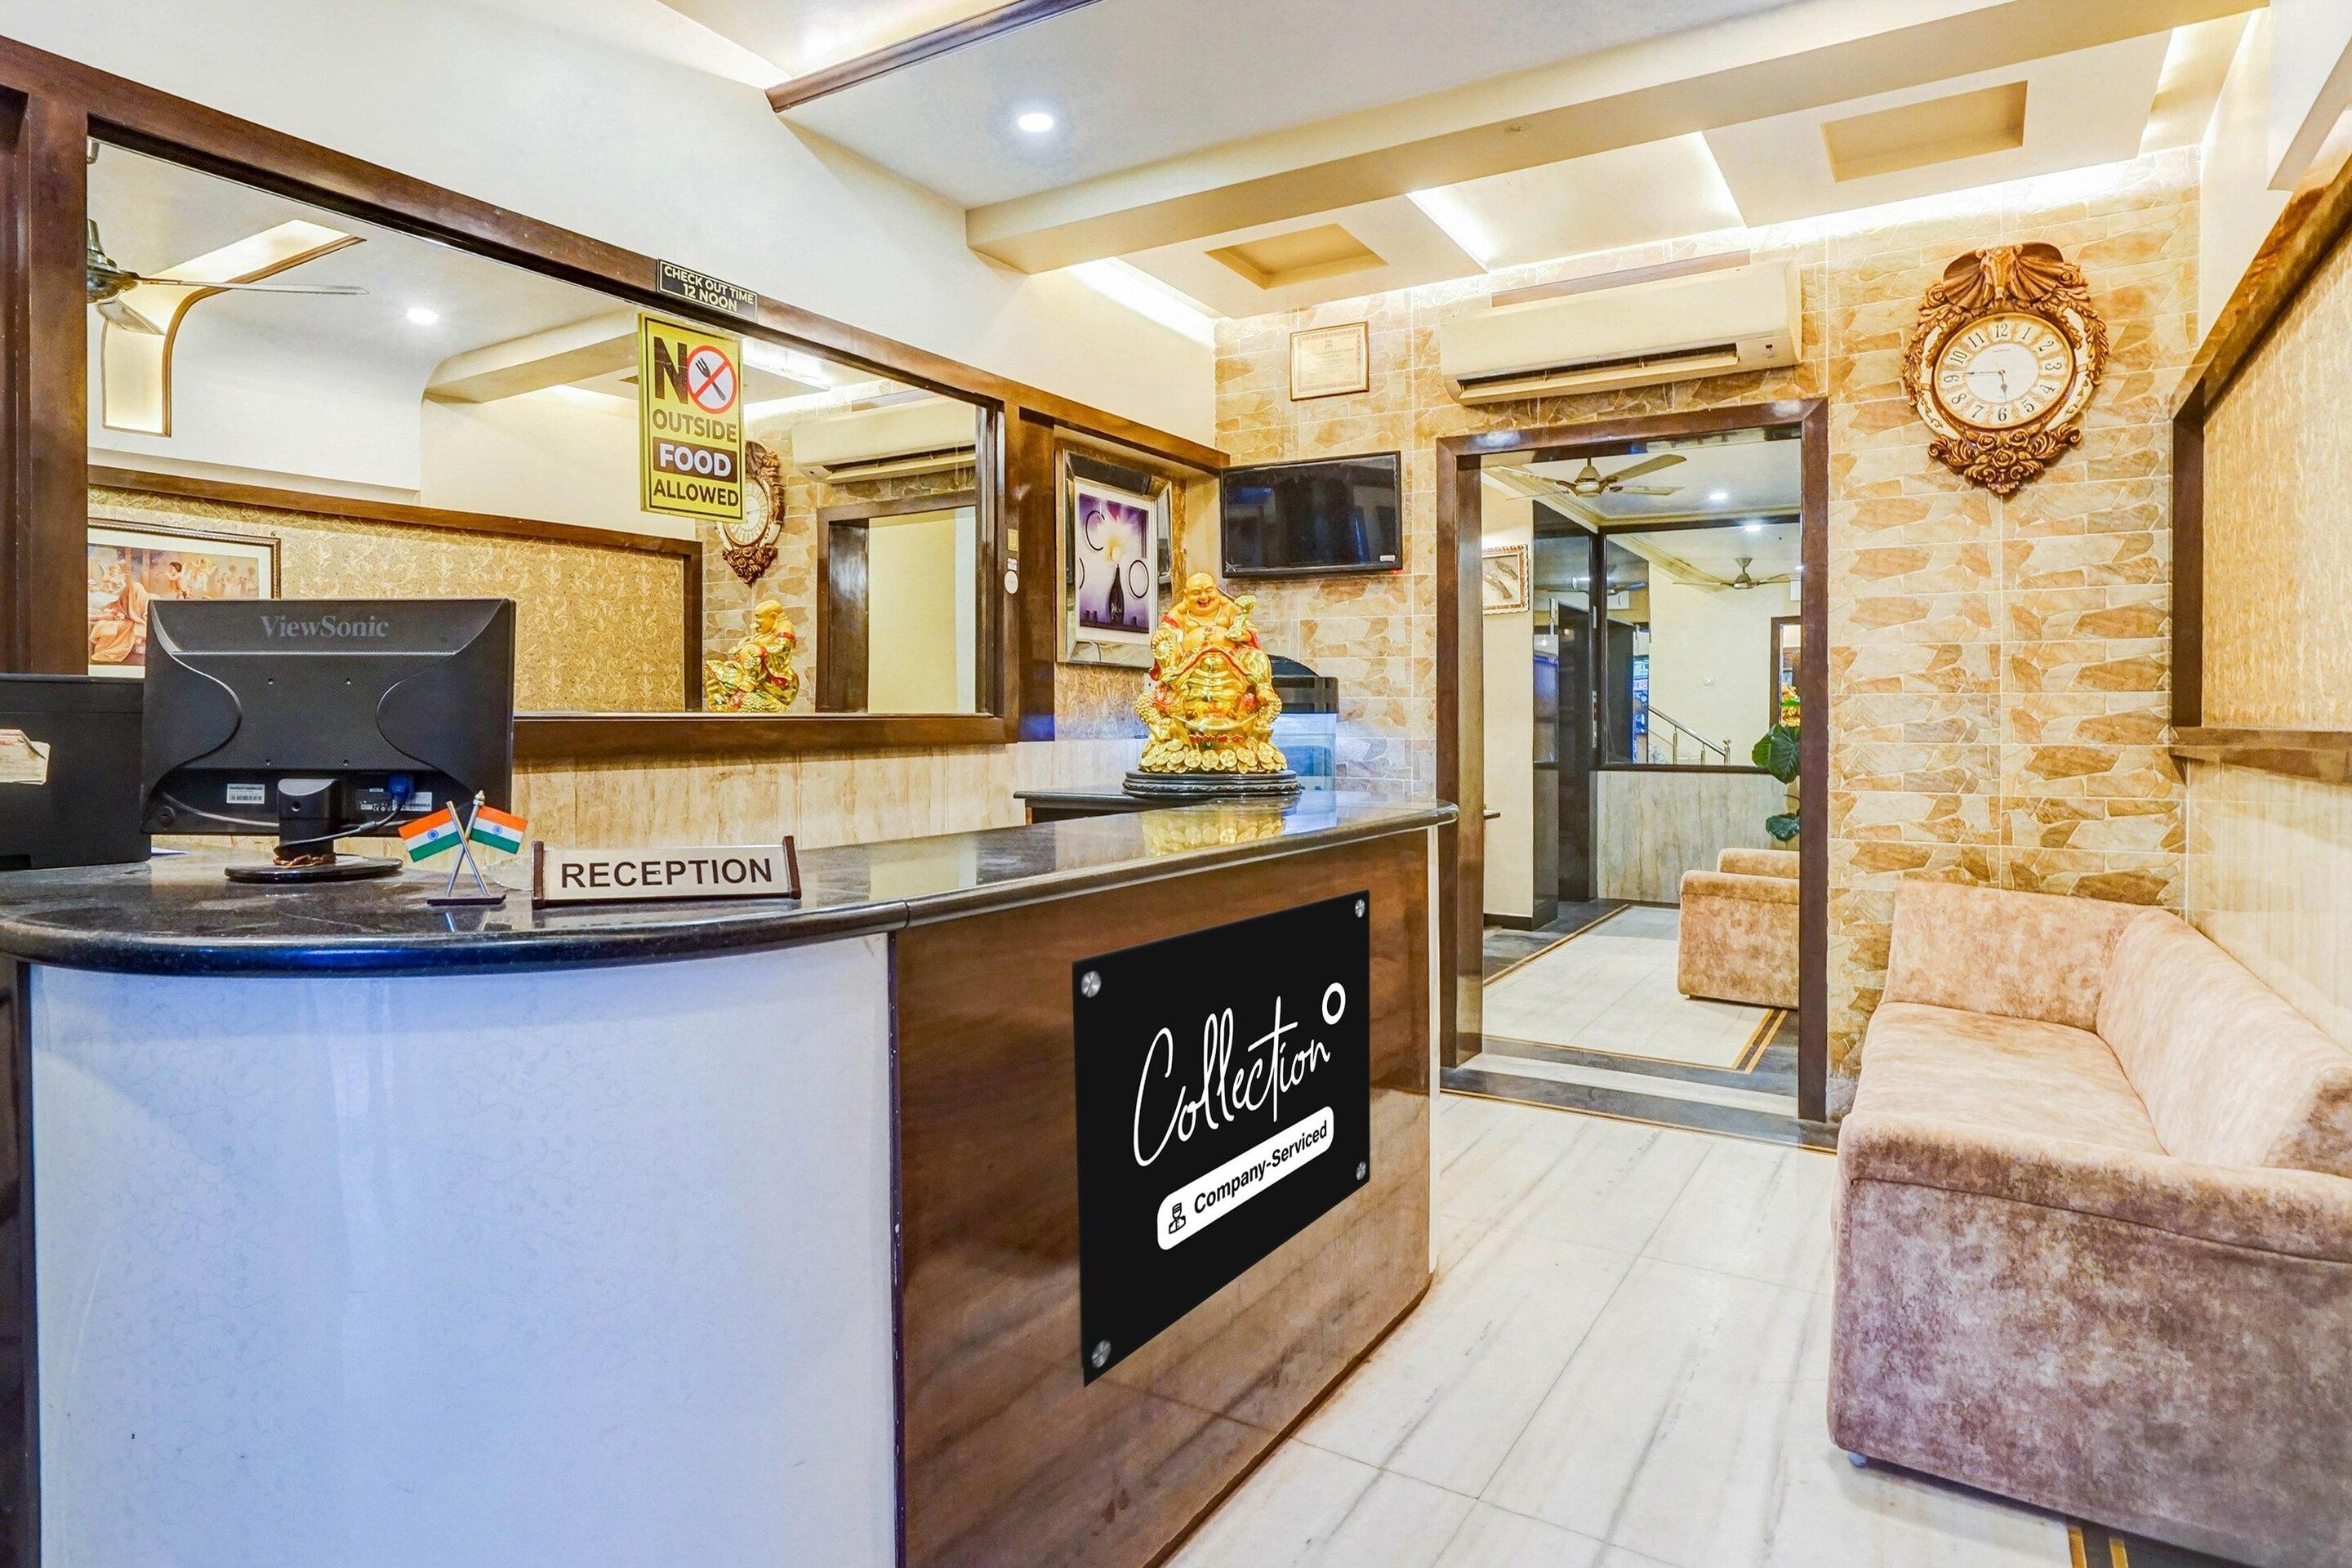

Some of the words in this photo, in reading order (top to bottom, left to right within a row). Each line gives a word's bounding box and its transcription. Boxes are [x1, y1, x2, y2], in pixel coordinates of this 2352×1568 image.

[664, 265, 703, 287] CHECK
[705, 279, 728, 295] OUT
[729, 287, 754, 305] TIME
[684, 283, 696, 299] 12
[699, 288, 737, 312] NOON
[1995, 323, 2008, 338] 12
[2022, 327, 2032, 340] 1
[1968, 332, 1984, 348] 11
[2038, 340, 2054, 352] 2
[1950, 350, 1967, 364] 10
[2045, 362, 2062, 371] 3
[1944, 374, 1959, 383] 9
[2039, 384, 2056, 394] 4
[1951, 393, 1967, 404] 8
[2021, 399, 2035, 413] 5
[1971, 405, 1984, 418] 7
[1998, 408, 2007, 421] 6
[653, 408, 737, 443] OUTSIDE
[659, 443, 732, 478] FOOD
[653, 479, 739, 507] ALLOWED
[260, 615, 390, 638] ViewSonic
[561, 858, 773, 889] RECEPTION
[1133, 996, 1331, 1167] Collection
[1194, 1120, 1328, 1214] Company-Serviced
